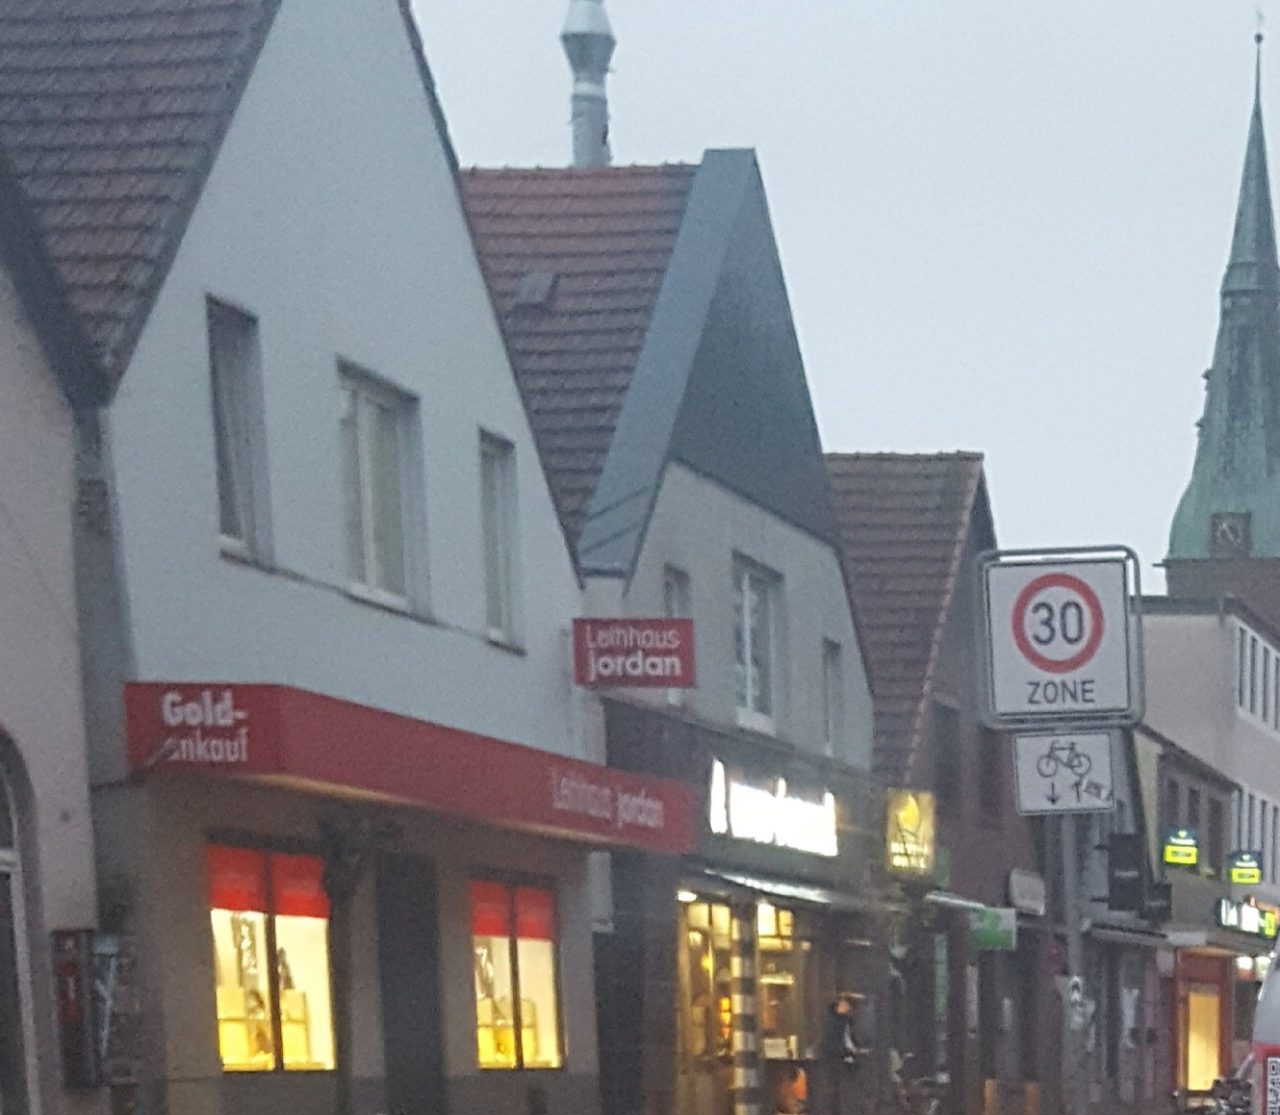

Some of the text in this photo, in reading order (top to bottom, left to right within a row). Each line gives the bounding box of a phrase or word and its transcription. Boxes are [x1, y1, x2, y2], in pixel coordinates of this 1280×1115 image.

[1031, 601, 1084, 645] 30
[588, 648, 682, 683] jordan
[162, 687, 249, 727] Gold-
[1026, 679, 1096, 704] ZONE
